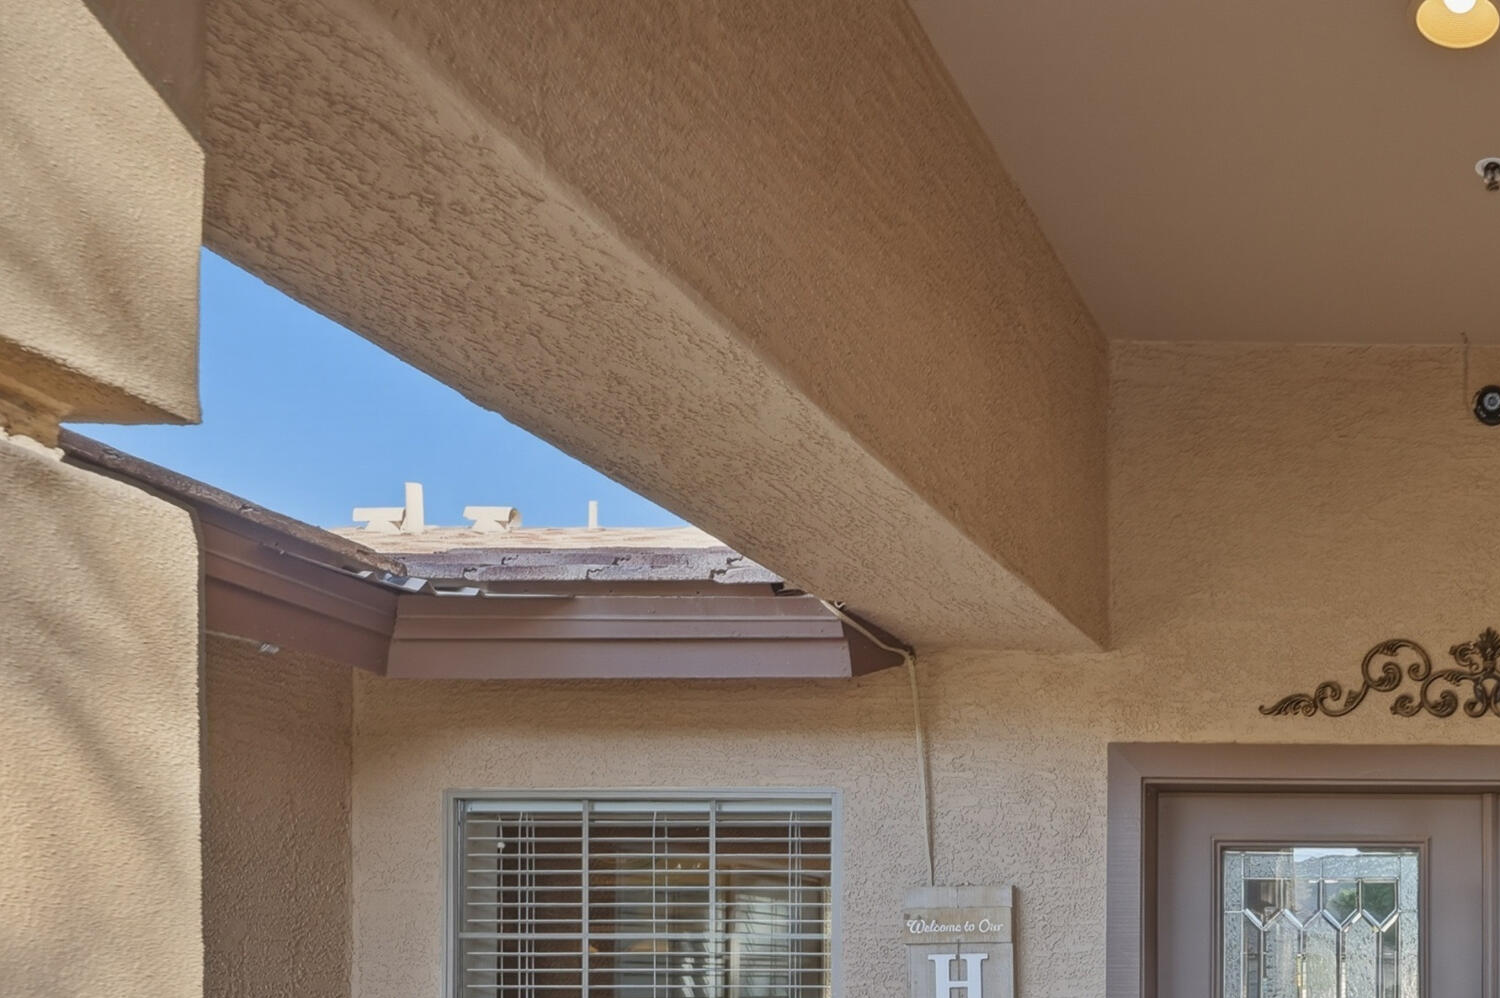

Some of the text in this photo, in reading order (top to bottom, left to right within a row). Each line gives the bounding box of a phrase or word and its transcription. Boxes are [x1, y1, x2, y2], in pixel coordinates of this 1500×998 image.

[906, 918, 1004, 934] Welcome to Our
